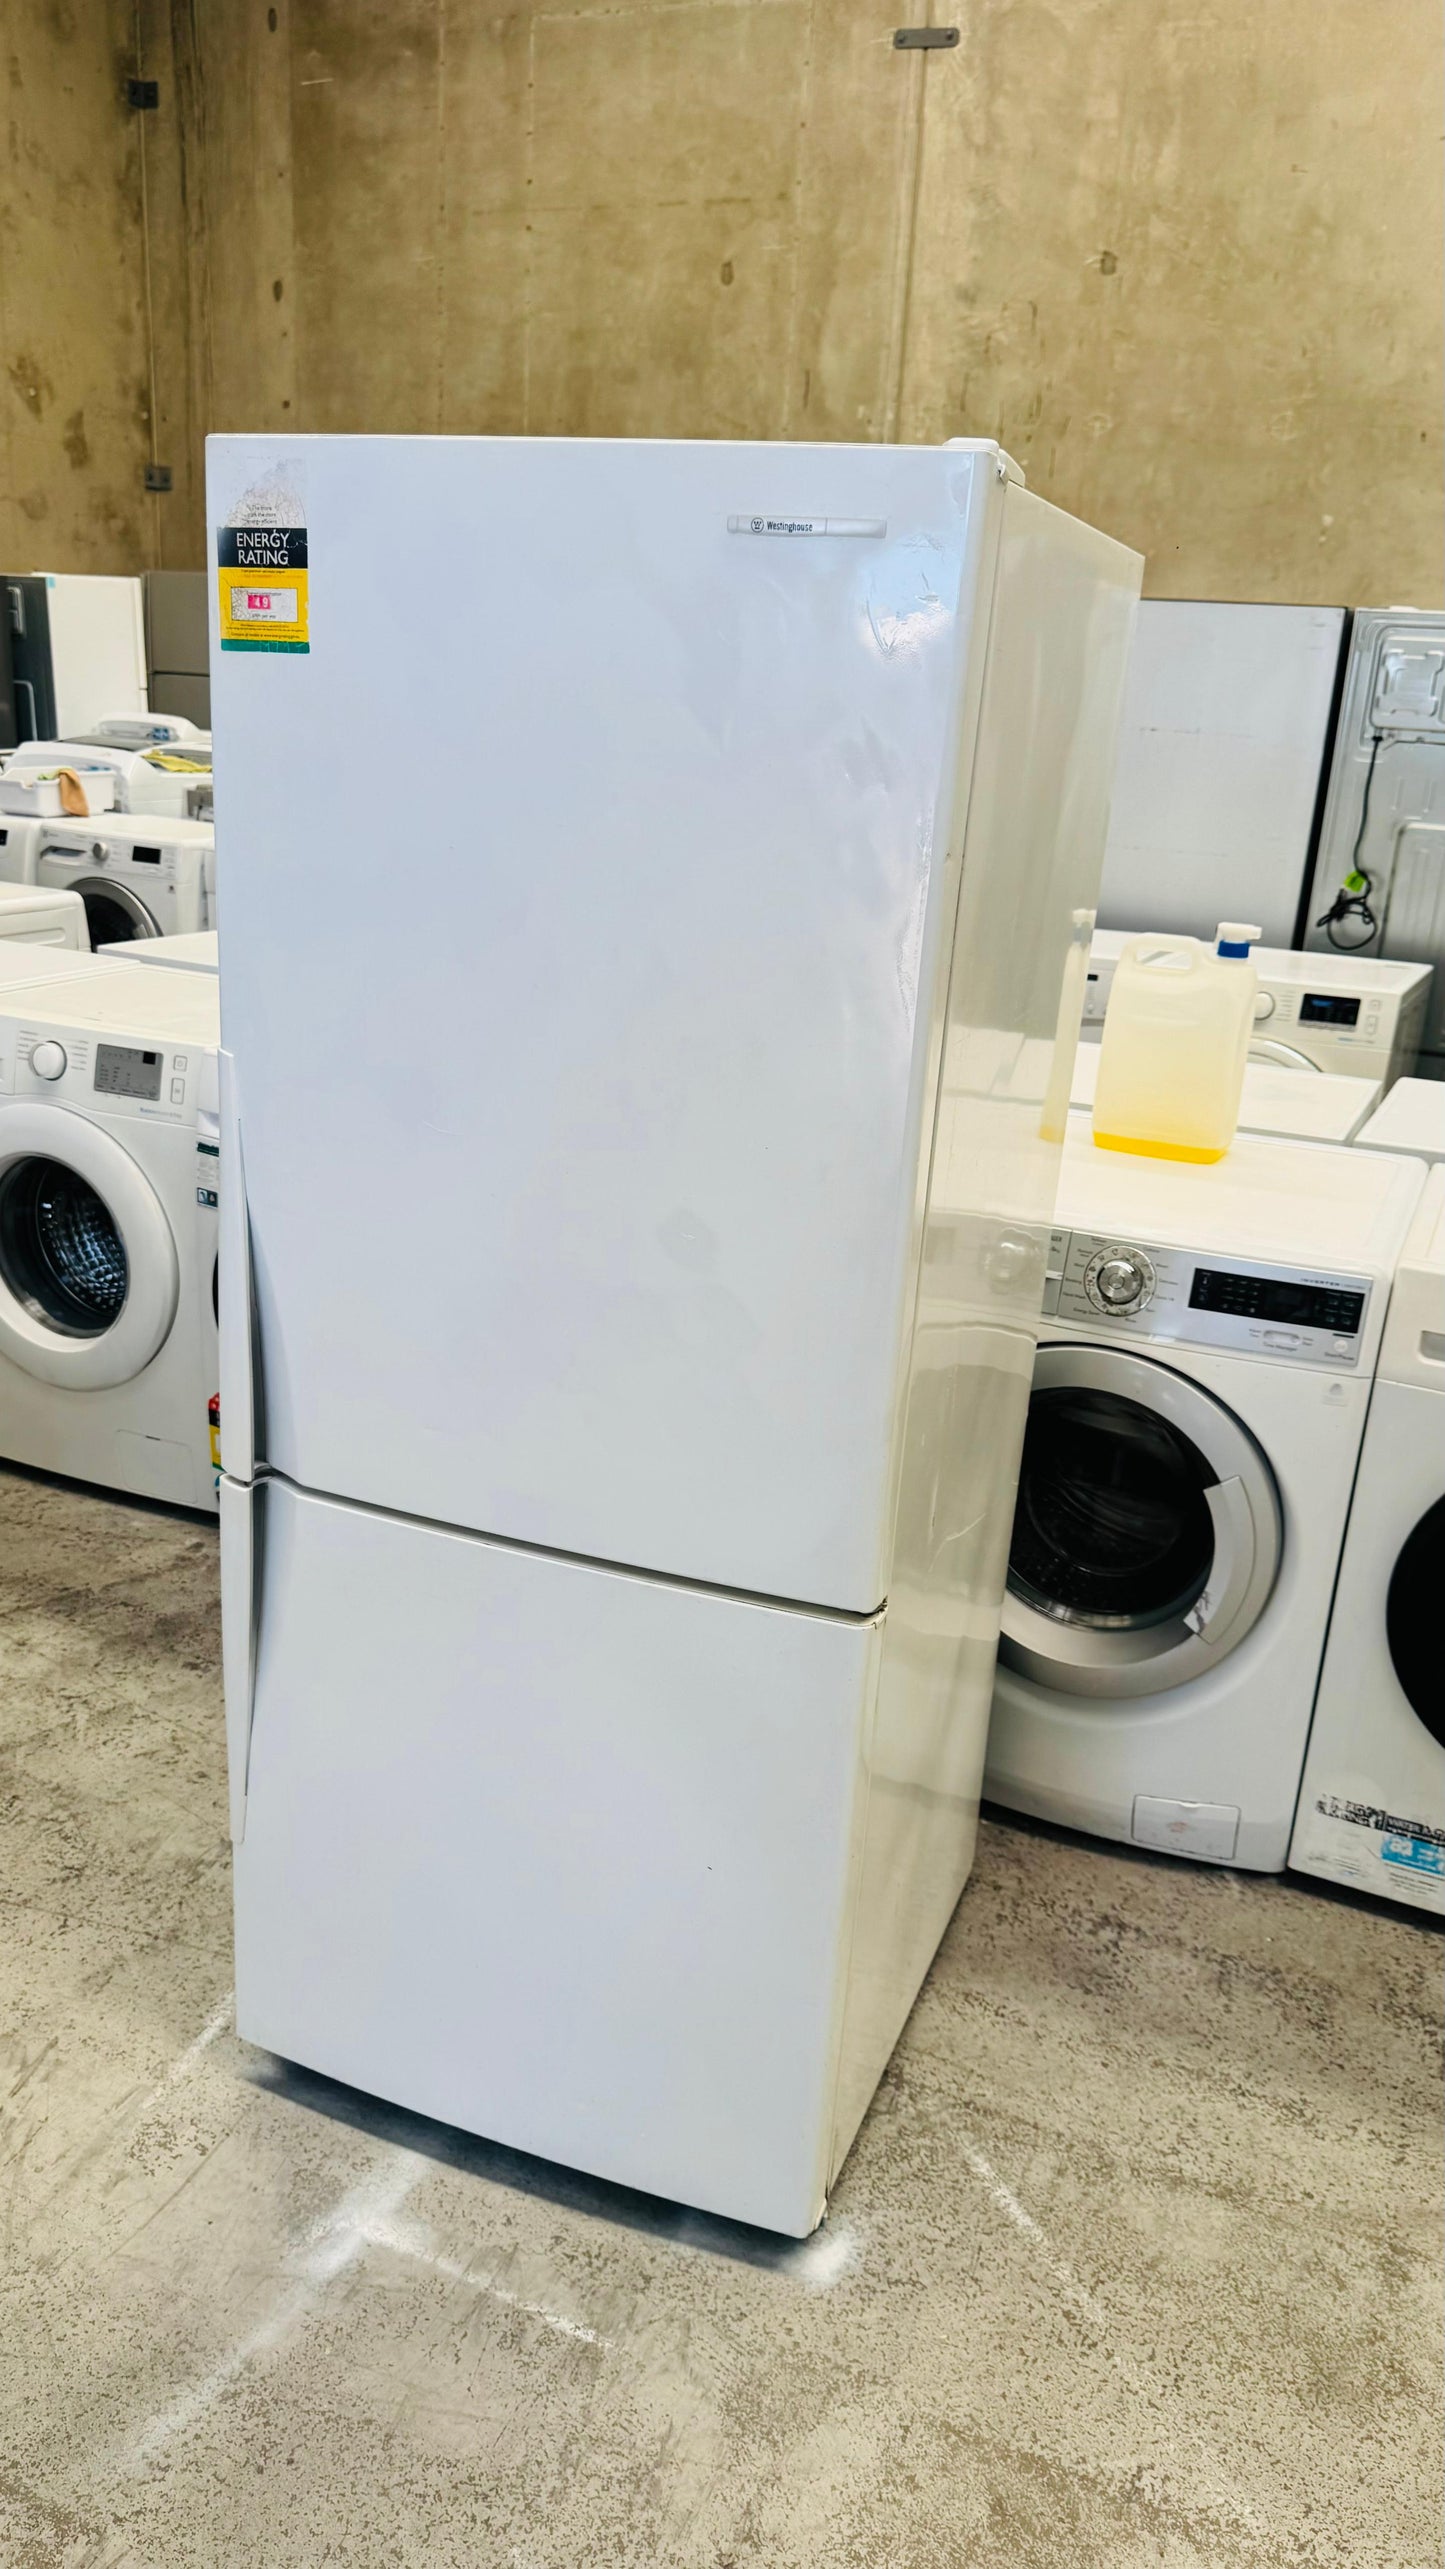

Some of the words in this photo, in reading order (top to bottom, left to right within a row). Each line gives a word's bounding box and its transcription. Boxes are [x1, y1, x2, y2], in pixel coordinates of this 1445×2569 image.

[766, 520, 813, 533] Westinghouse
[236, 532, 290, 548] ENERGY
[238, 549, 289, 566] RATING
